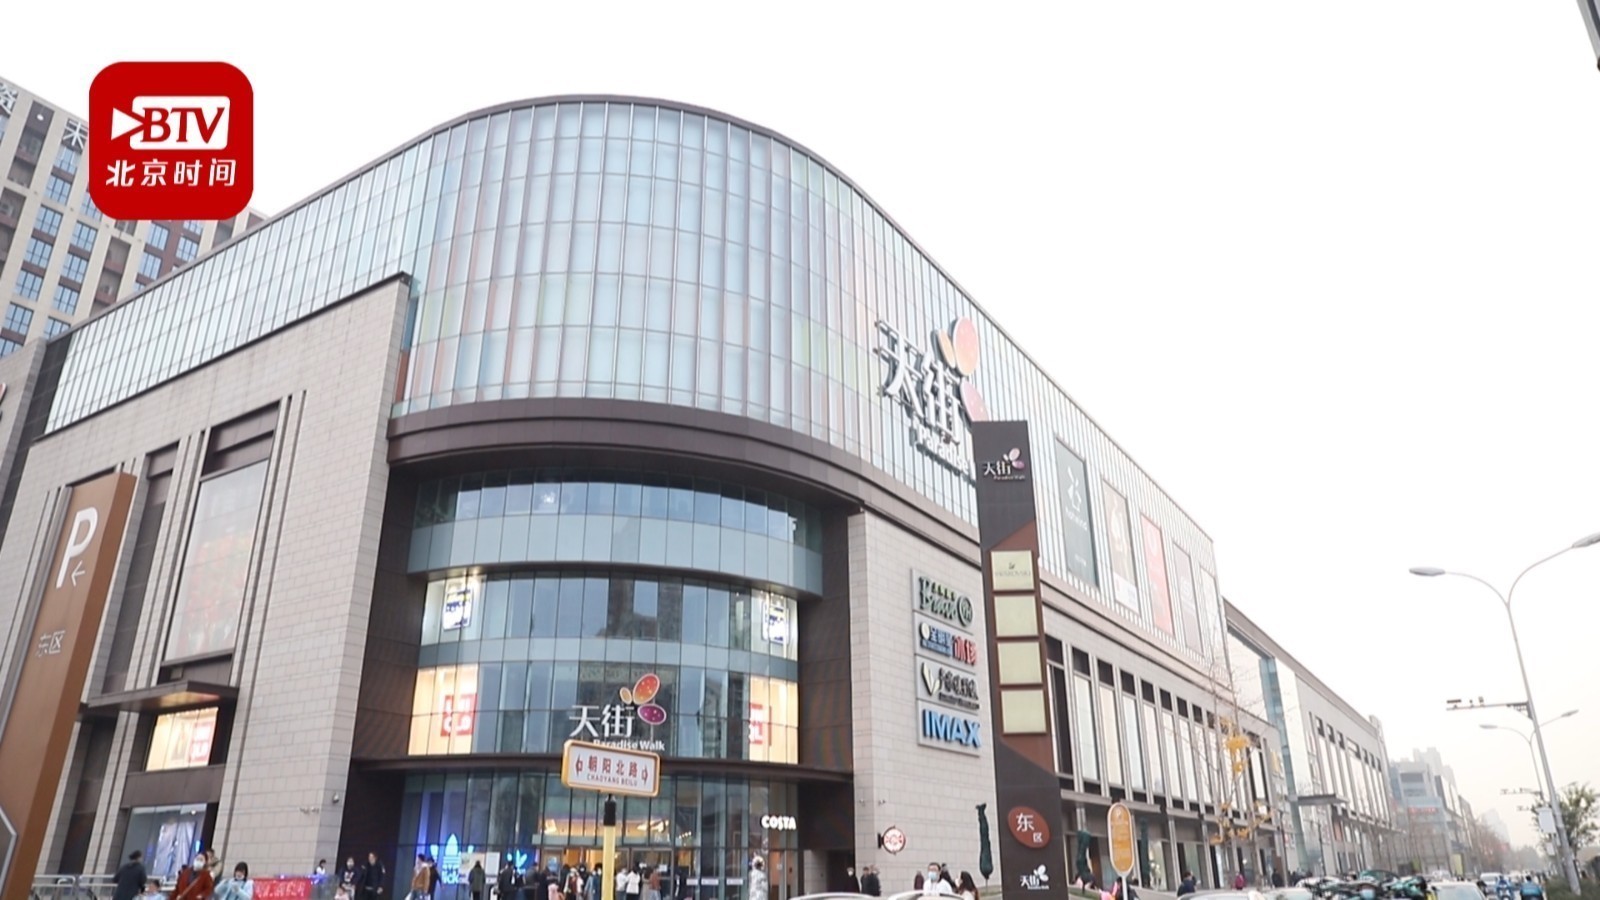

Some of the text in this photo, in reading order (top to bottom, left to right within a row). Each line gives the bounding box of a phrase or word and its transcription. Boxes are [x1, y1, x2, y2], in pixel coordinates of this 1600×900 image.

[874, 320, 962, 445] 天街
[983, 461, 1011, 475] 天街
[56, 507, 98, 589] P
[35, 629, 65, 658] 东区
[569, 704, 635, 738] 天街
[922, 708, 981, 749] IMAX
[639, 741, 665, 751] Walk
[587, 774, 619, 785] CHAOYANG
[588, 755, 638, 778] 朝阳北路
[761, 814, 797, 831] COSTA
